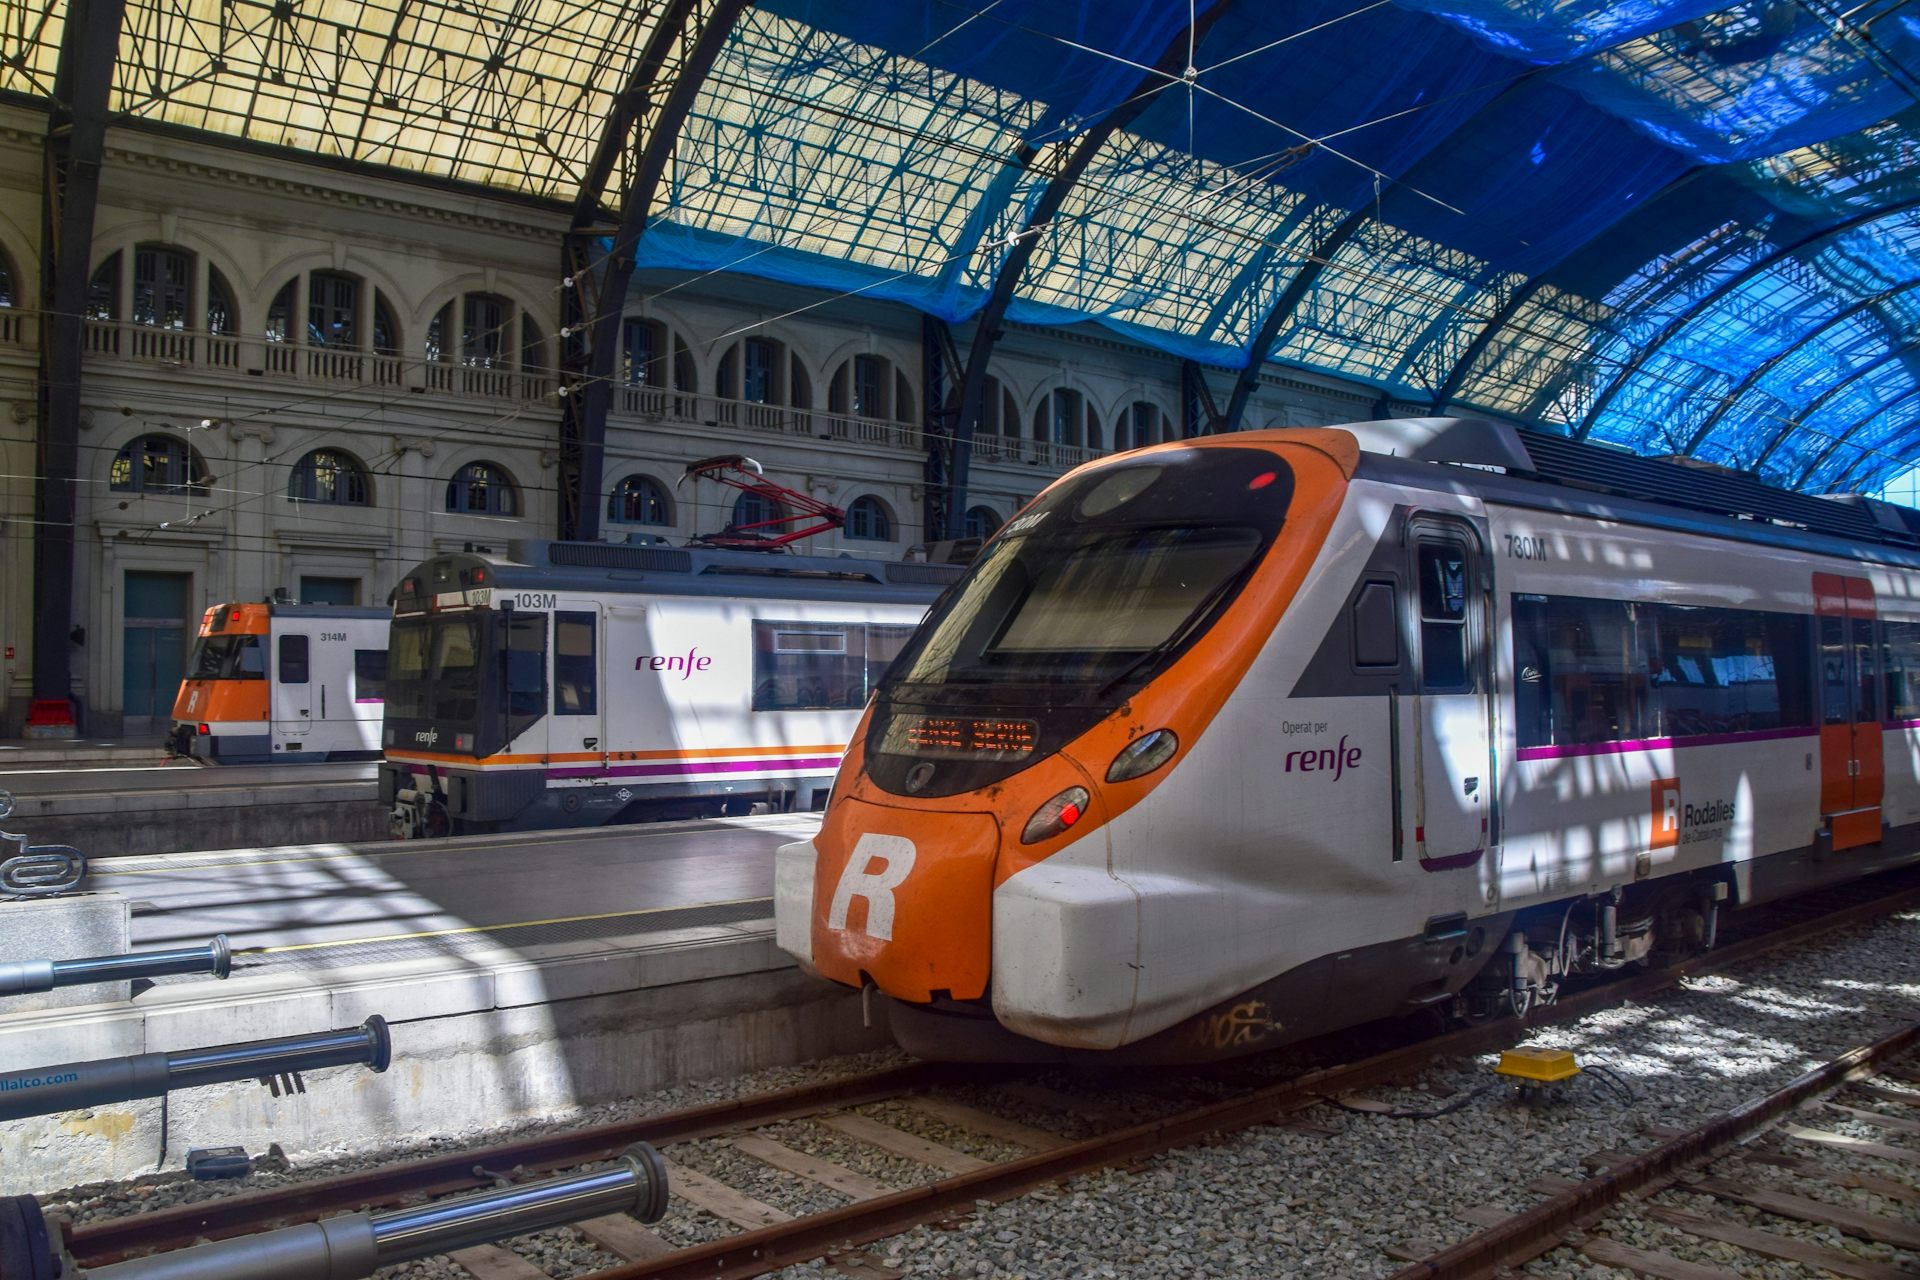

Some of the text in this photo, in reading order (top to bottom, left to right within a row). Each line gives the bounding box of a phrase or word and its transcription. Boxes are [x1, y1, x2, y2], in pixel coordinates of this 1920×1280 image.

[1504, 534, 1546, 562] 730M
[514, 593, 557, 609] 103M
[320, 633, 347, 642] 314M
[635, 646, 712, 681] renfe
[415, 726, 438, 748] renfe
[1282, 720, 1328, 736] Operat per
[1285, 734, 1362, 782] renfe
[1684, 800, 1736, 828] Rodalies
[828, 832, 917, 942] R
